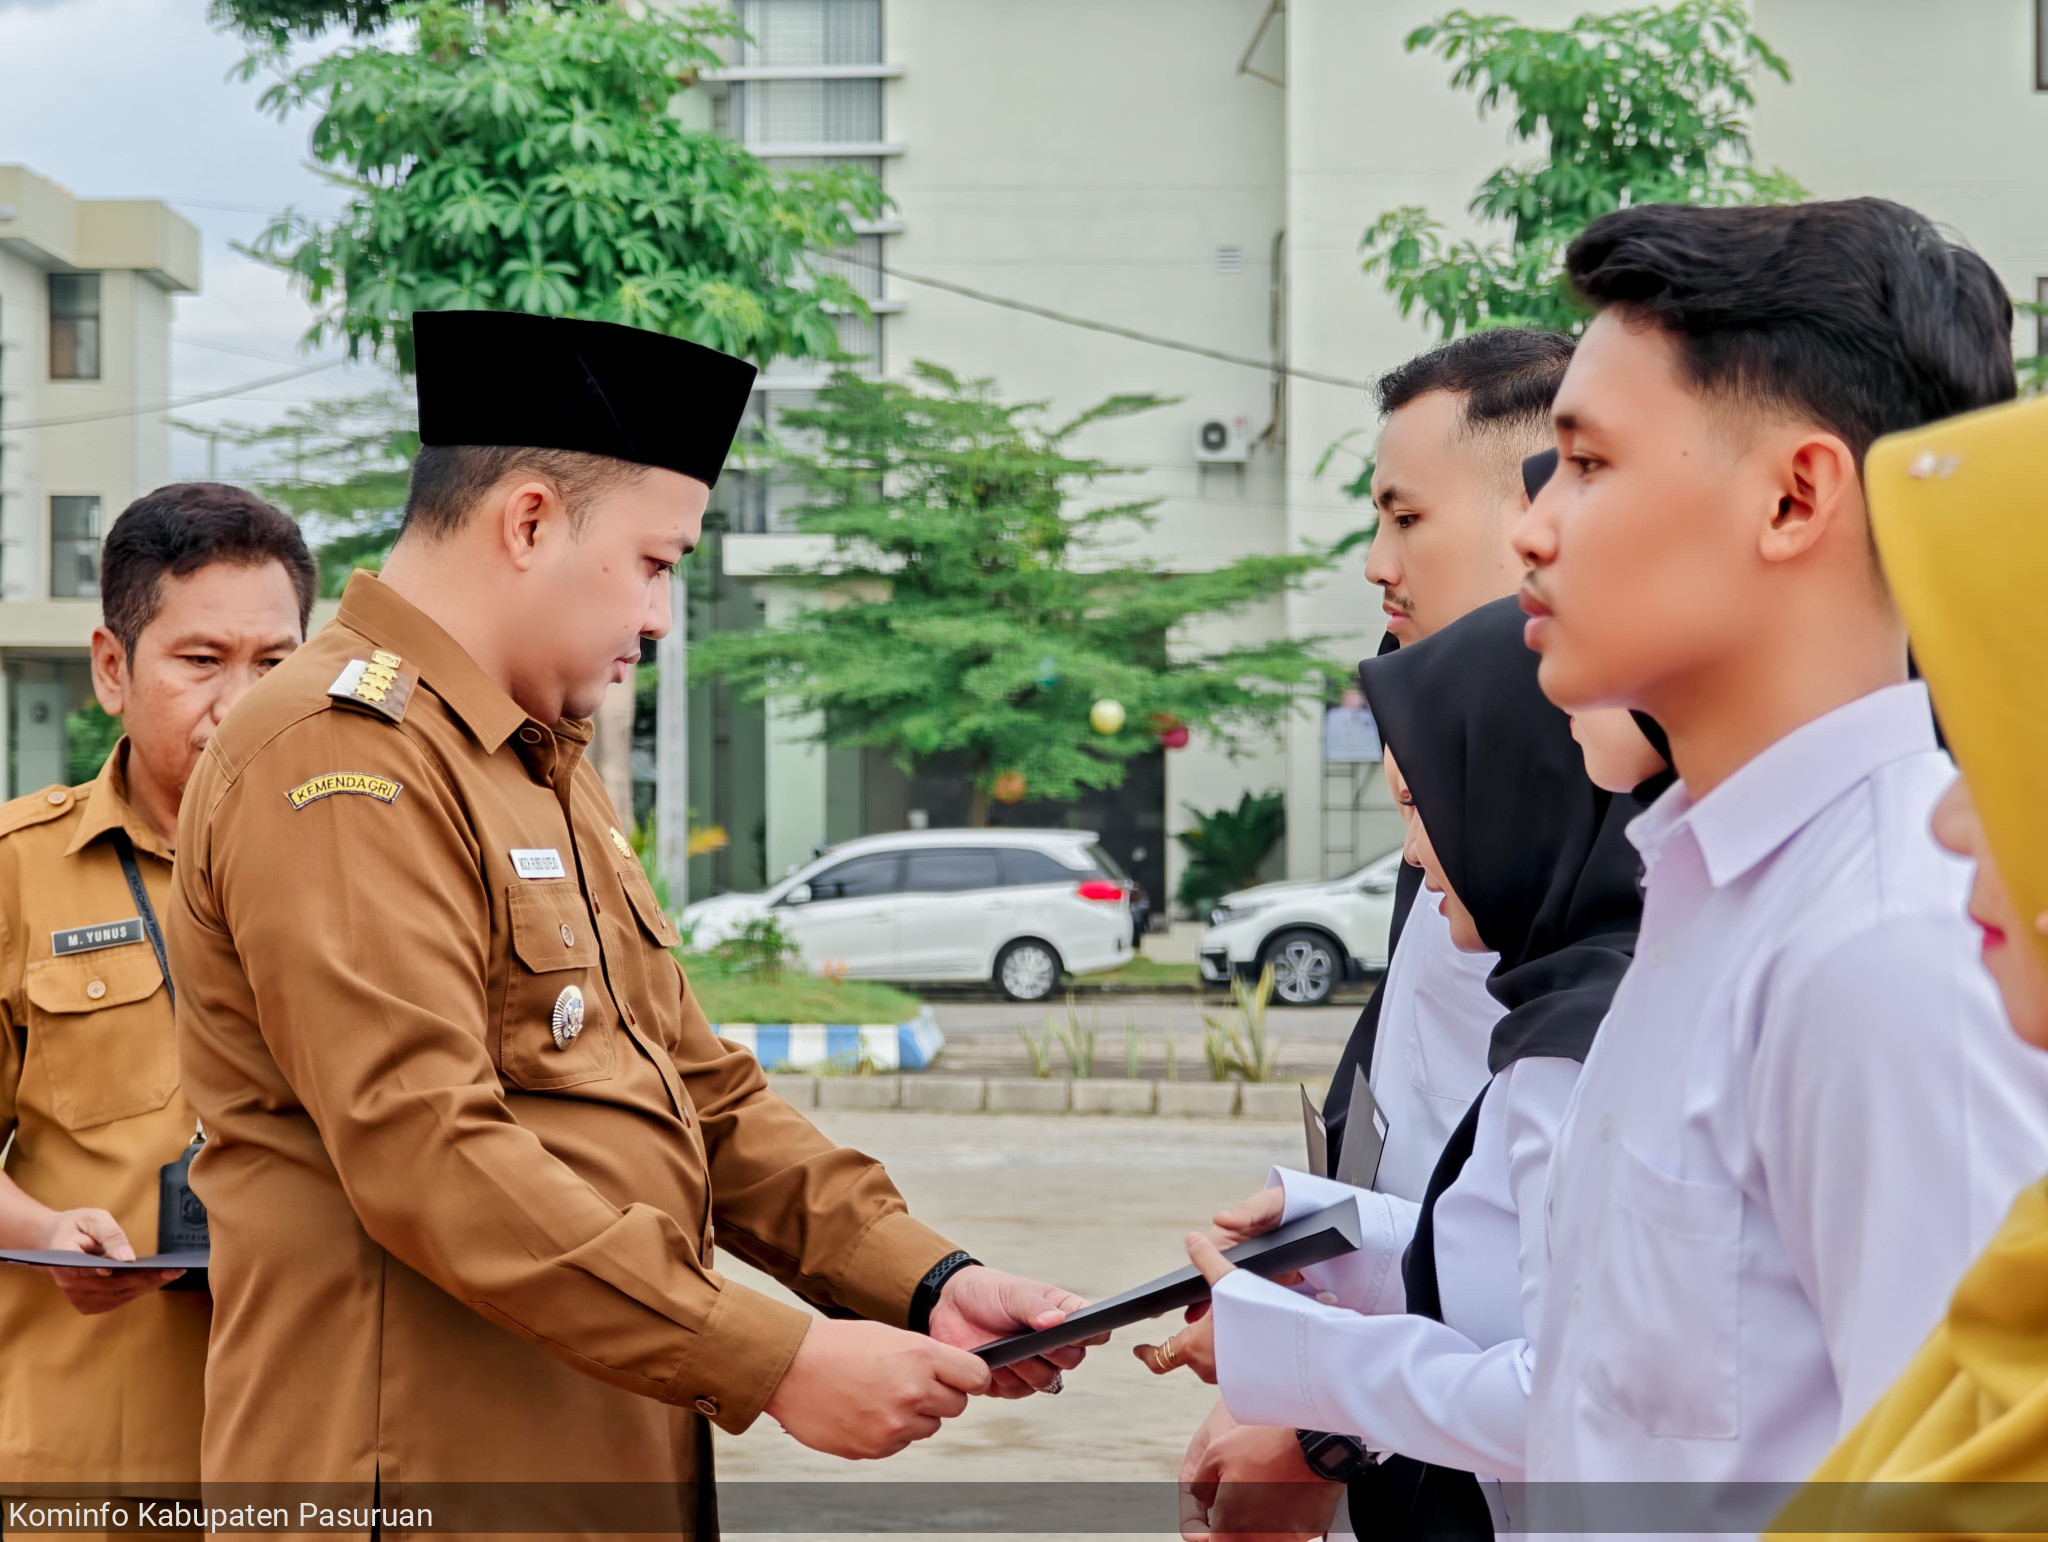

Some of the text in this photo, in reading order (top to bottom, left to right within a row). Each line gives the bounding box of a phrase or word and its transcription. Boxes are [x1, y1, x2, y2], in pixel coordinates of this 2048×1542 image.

[297, 776, 393, 802] KEMENDAGRI
[68, 926, 127, 947] M. YUNUS
